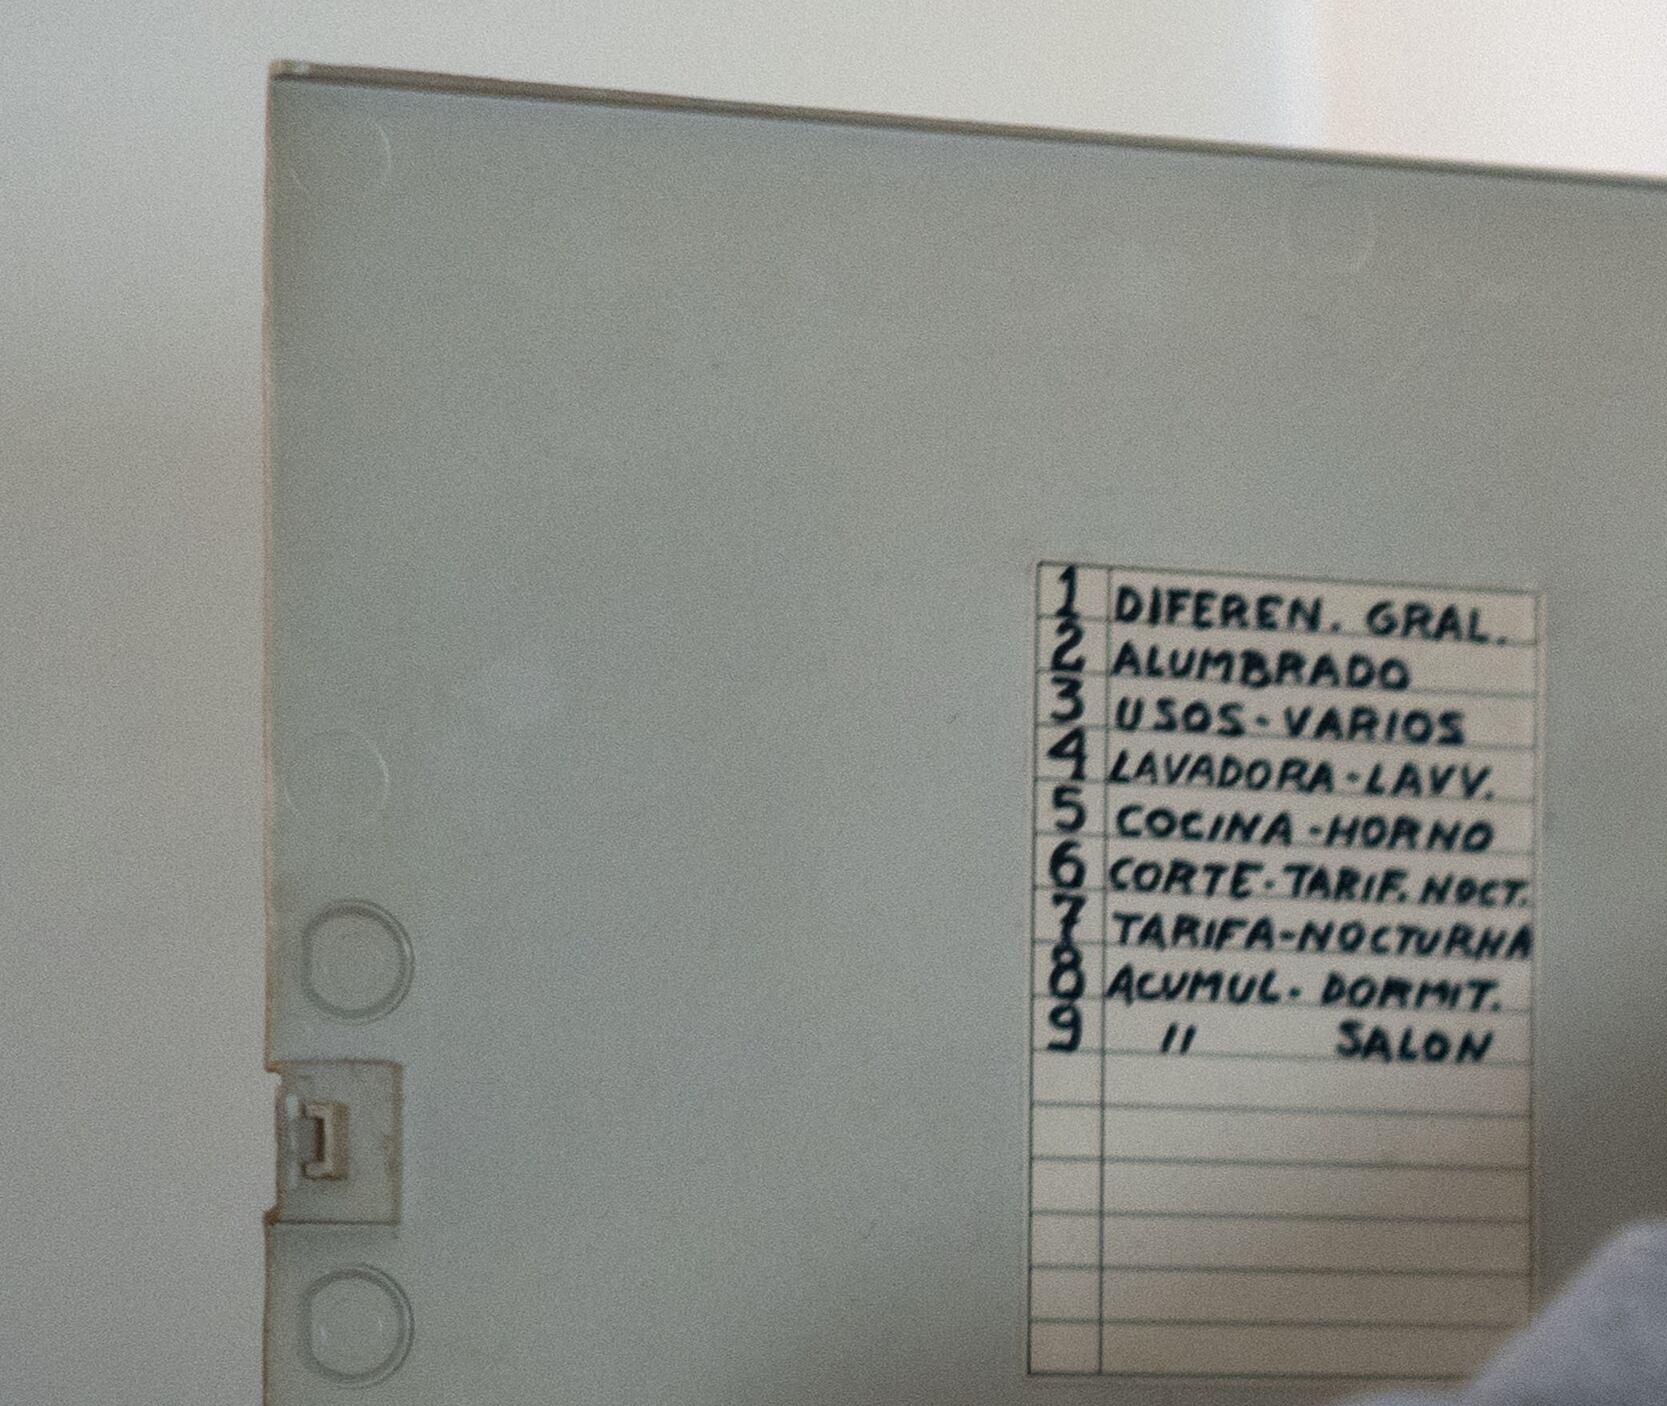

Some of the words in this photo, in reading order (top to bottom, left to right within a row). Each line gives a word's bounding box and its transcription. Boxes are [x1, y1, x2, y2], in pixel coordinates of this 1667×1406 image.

[1055, 566, 1076, 617] 1
[1114, 586, 1341, 635] DIFEREN.
[1365, 600, 1508, 647] GRAL.
[1051, 619, 1086, 673] 2
[1111, 640, 1412, 691] ALUMBRADO
[1050, 676, 1085, 724] 3
[1046, 728, 1087, 782] 4
[1054, 787, 1087, 833] 5
[1048, 840, 1086, 890] 6
[1051, 894, 1087, 943] 7
[1048, 944, 1086, 1000] 8
[1320, 971, 1503, 1013] DORMIT.
[1046, 1003, 1083, 1052] 9
[1336, 1018, 1495, 1064] SALON
